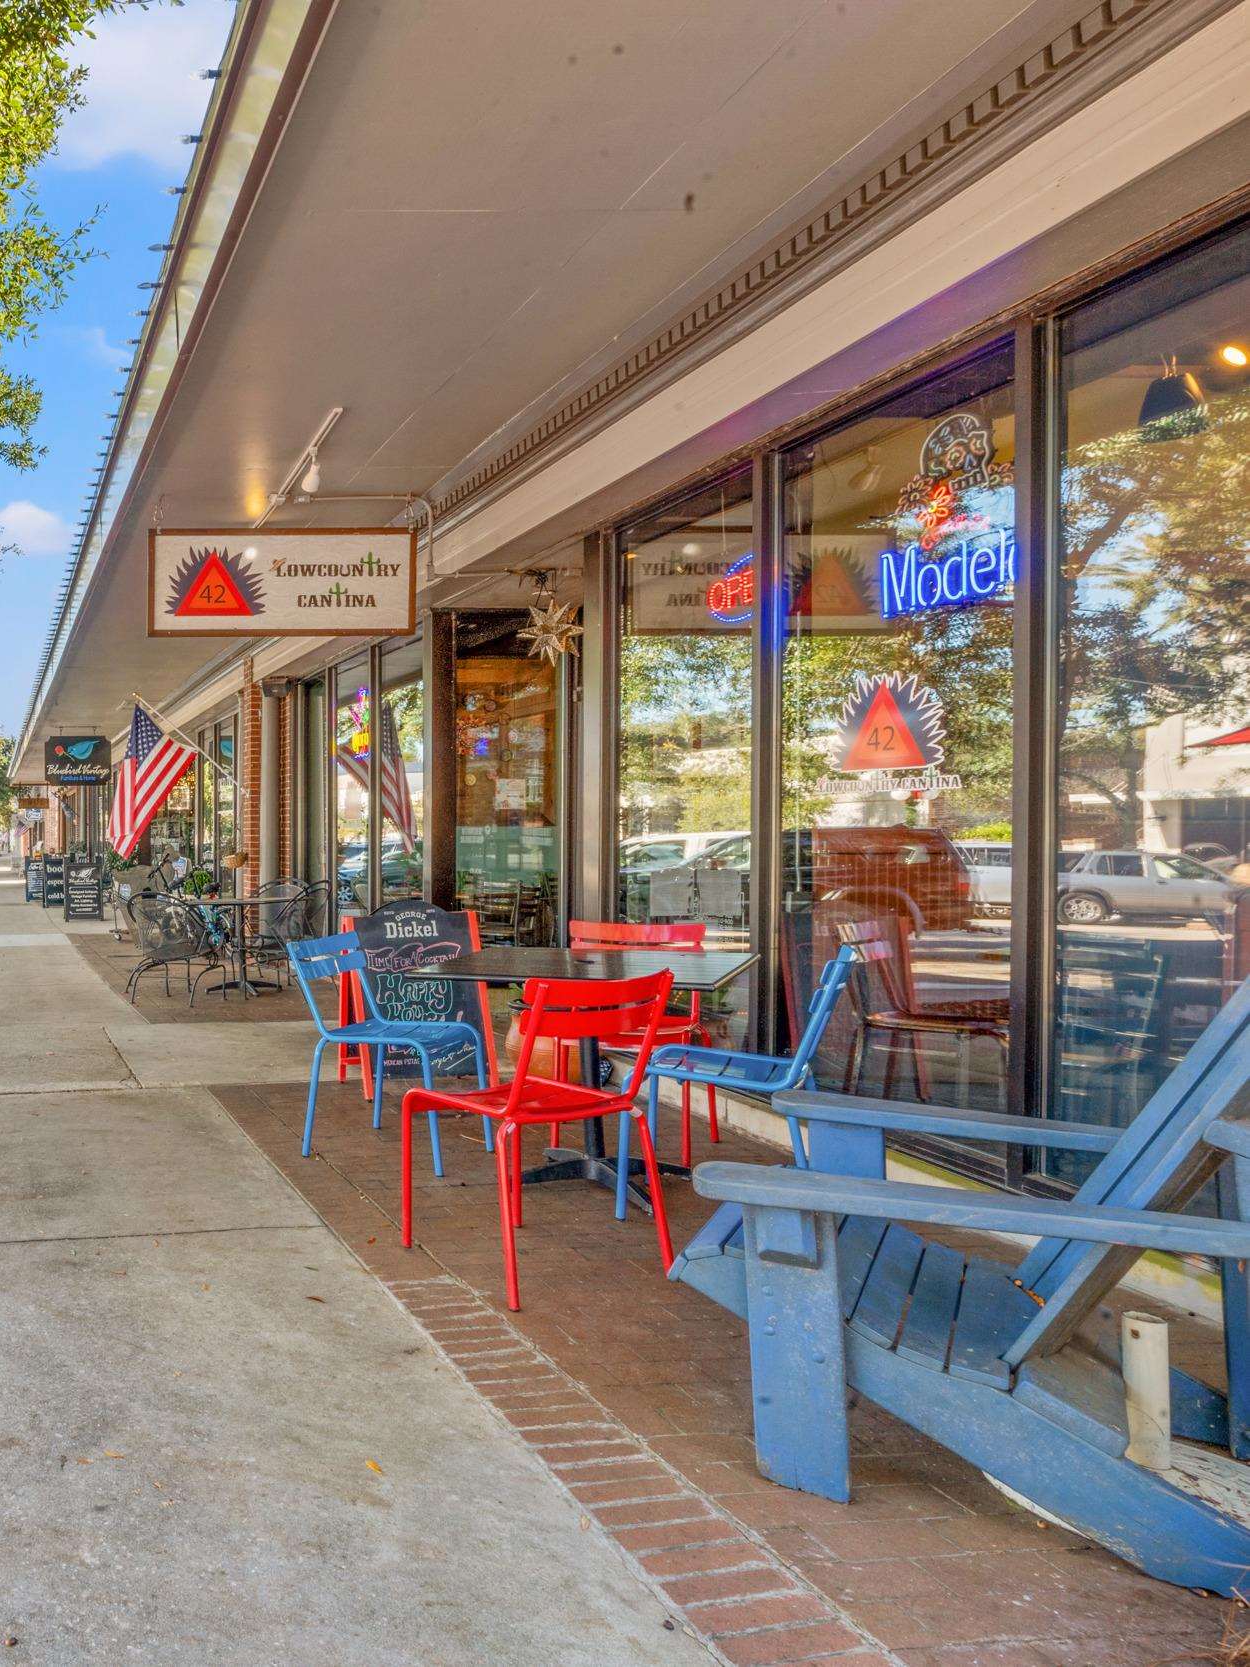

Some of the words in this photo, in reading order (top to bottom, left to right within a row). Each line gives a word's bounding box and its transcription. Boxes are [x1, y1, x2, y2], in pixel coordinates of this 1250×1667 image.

[274, 552, 401, 577] LOWCOUNTRY
[198, 584, 227, 604] 42
[297, 582, 377, 608] CANTINA
[707, 566, 754, 612] OPE
[867, 726, 895, 751] 42
[900, 765, 962, 789] CANTINA
[46, 864, 64, 873] boo
[395, 911, 427, 921] GEORGE
[384, 920, 439, 939] Dickel
